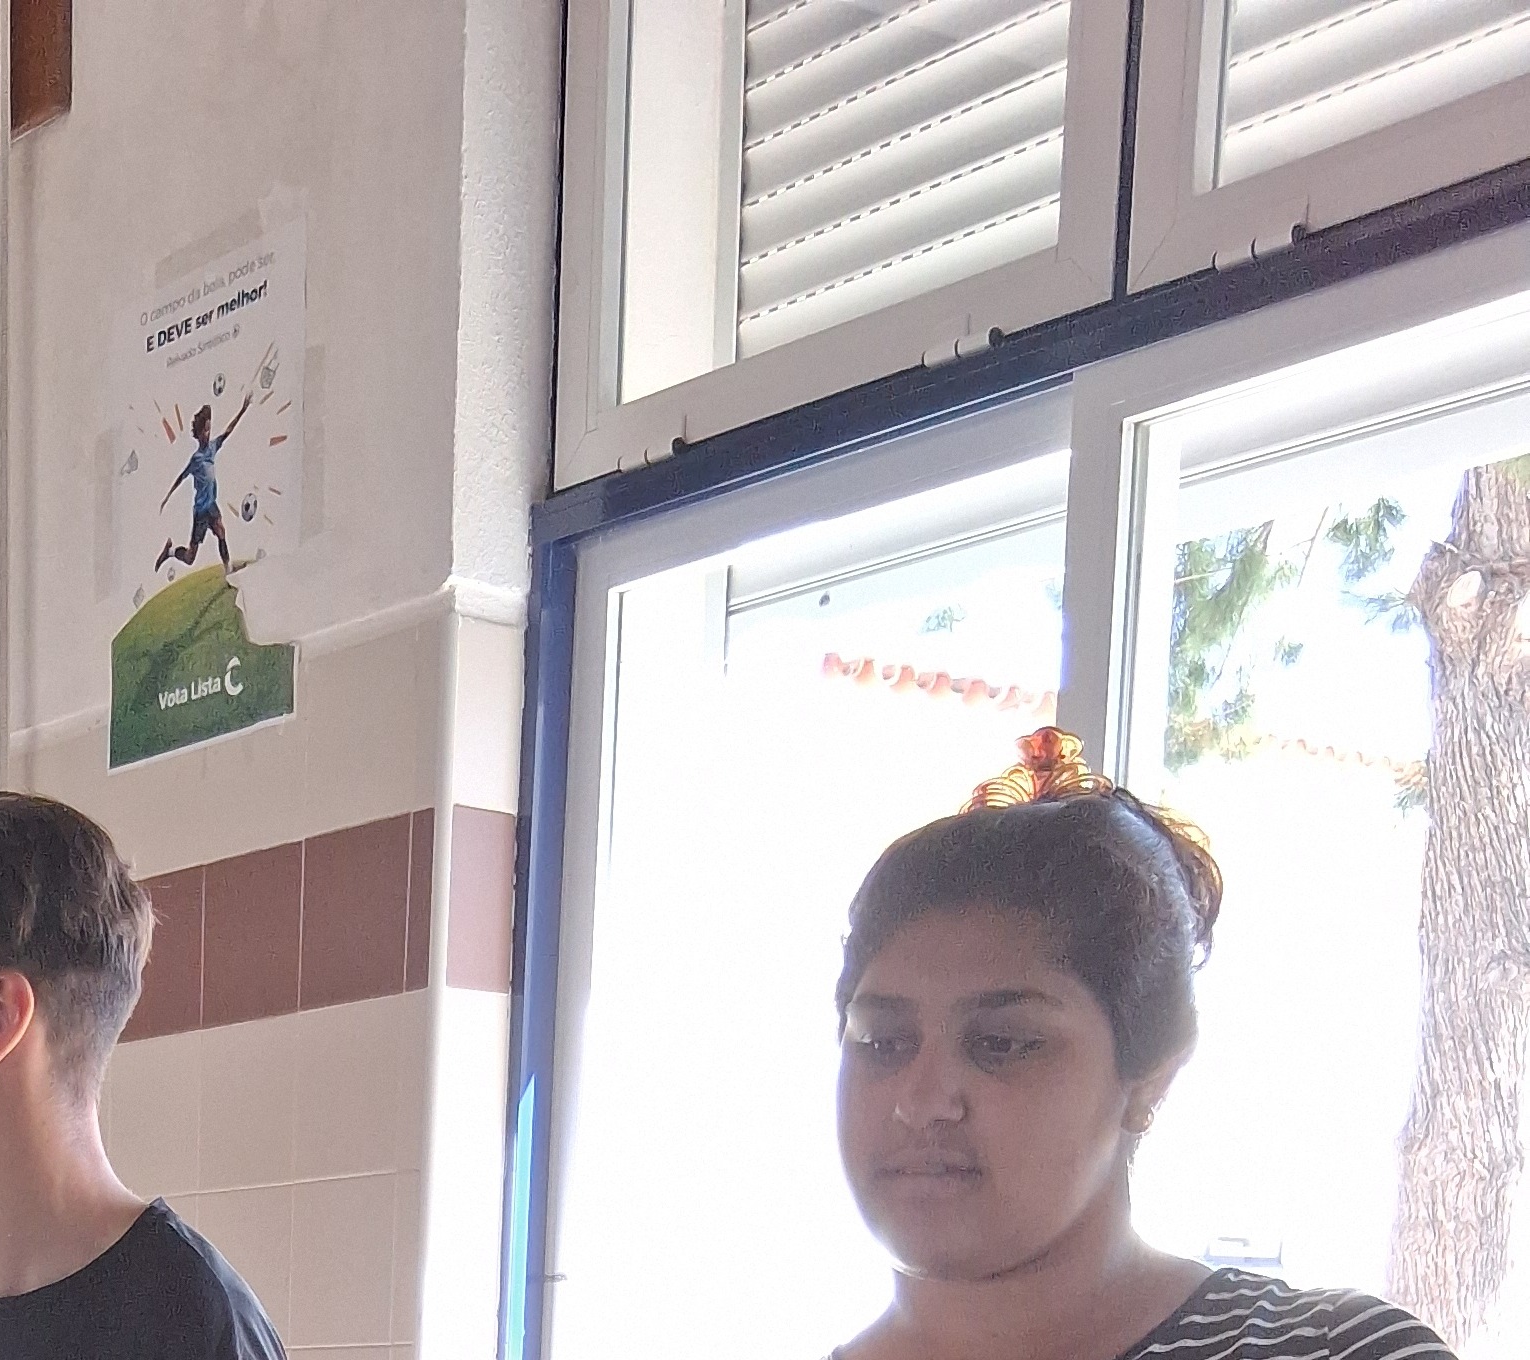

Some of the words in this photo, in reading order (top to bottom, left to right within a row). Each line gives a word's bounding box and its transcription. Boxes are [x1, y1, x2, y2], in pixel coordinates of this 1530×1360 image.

[146, 335, 155, 353] E
[157, 317, 192, 348] DEVE
[195, 309, 215, 330] ser
[216, 279, 268, 319] melhor!
[158, 687, 188, 710] Vota
[190, 675, 222, 700] Lista
[224, 655, 244, 696] C
